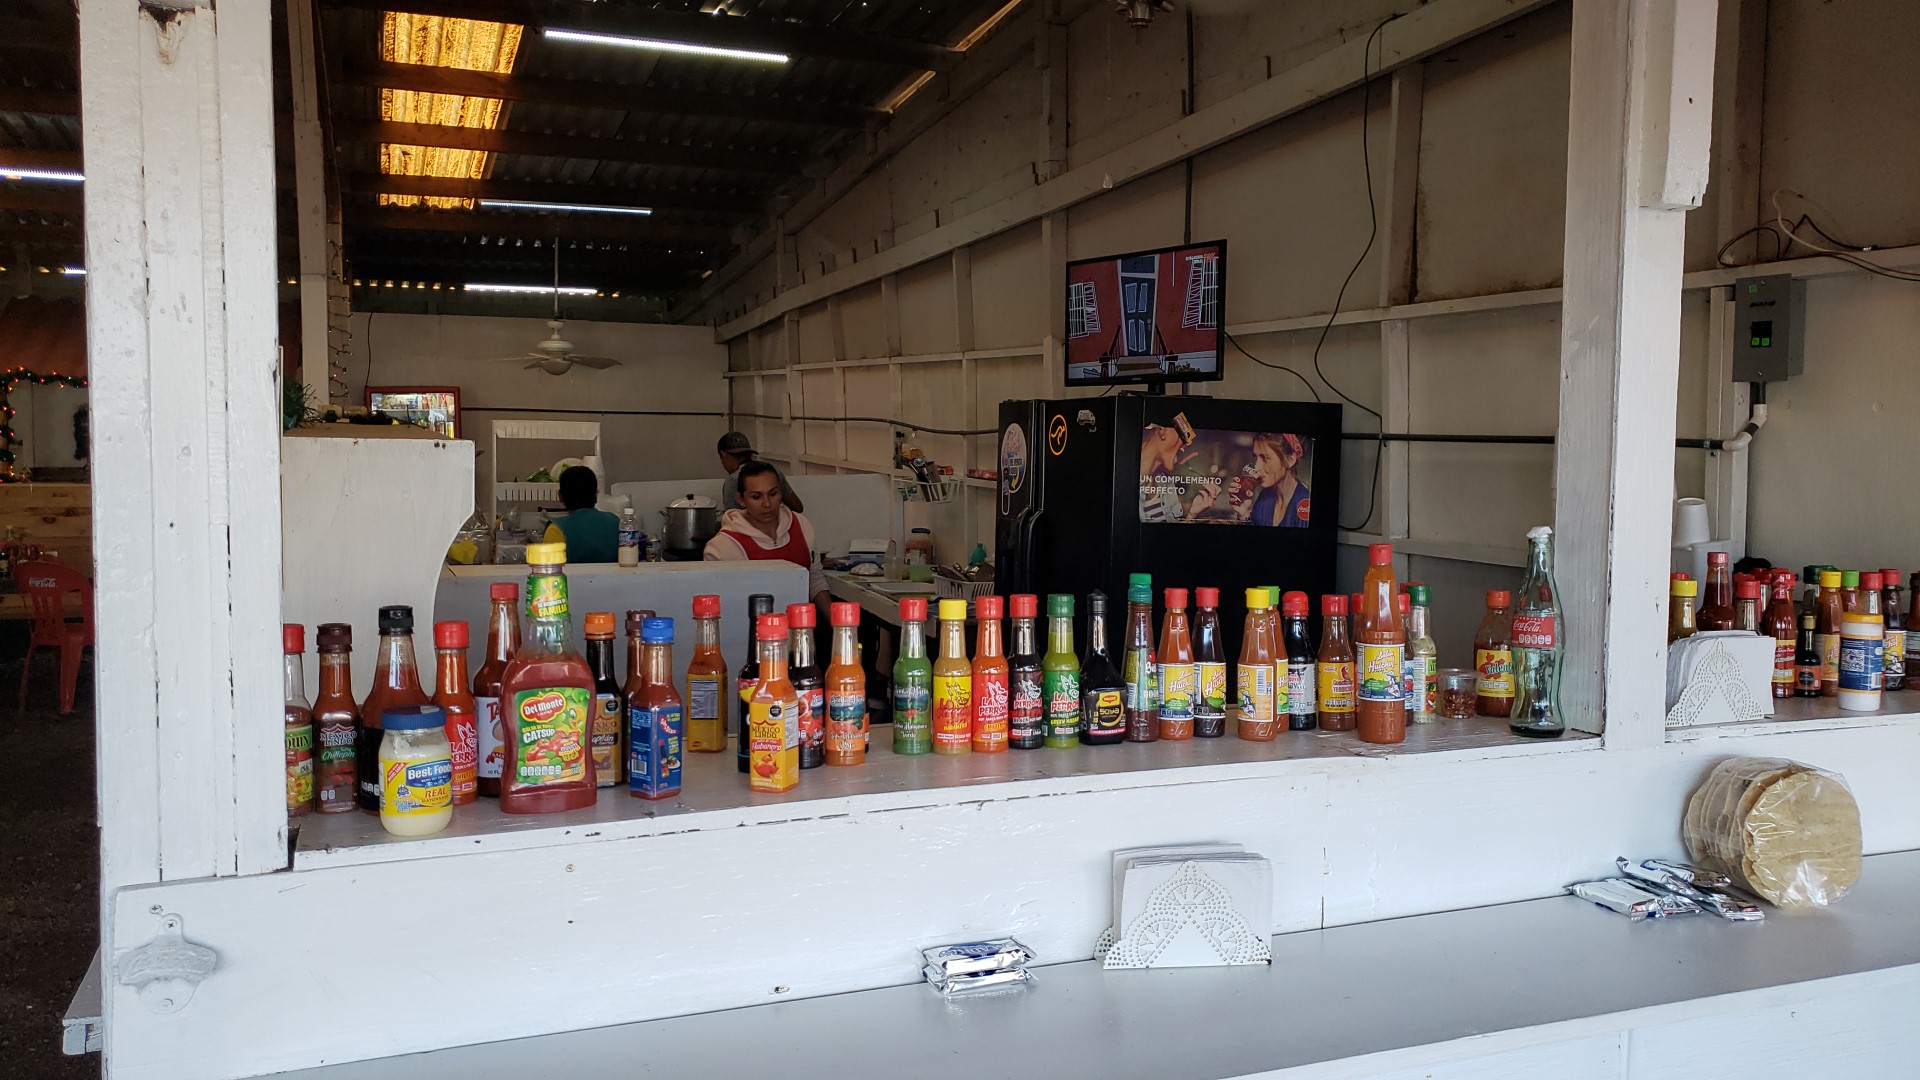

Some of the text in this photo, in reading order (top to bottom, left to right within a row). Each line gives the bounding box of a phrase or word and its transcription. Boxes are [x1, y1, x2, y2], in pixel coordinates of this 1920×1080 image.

[1140, 475, 1222, 485] UN COMPLEMENTO
[1139, 487, 1185, 495] PERFECTO
[538, 603, 568, 617] FAMILIA
[1513, 620, 1542, 632] Coca-Cola
[1376, 649, 1394, 660] Salsa
[1368, 655, 1395, 673] Huichol
[981, 696, 993, 706] LA
[1016, 692, 1027, 701] LA
[1053, 691, 1066, 702] LA
[524, 704, 537, 715] Del
[538, 699, 563, 710] Monte
[523, 728, 556, 743] CATSUP
[324, 738, 354, 747] LINDO
[752, 743, 782, 753] Habanero
[408, 767, 432, 780] Best
[434, 763, 452, 775] Foods
[425, 787, 446, 798] REAL
